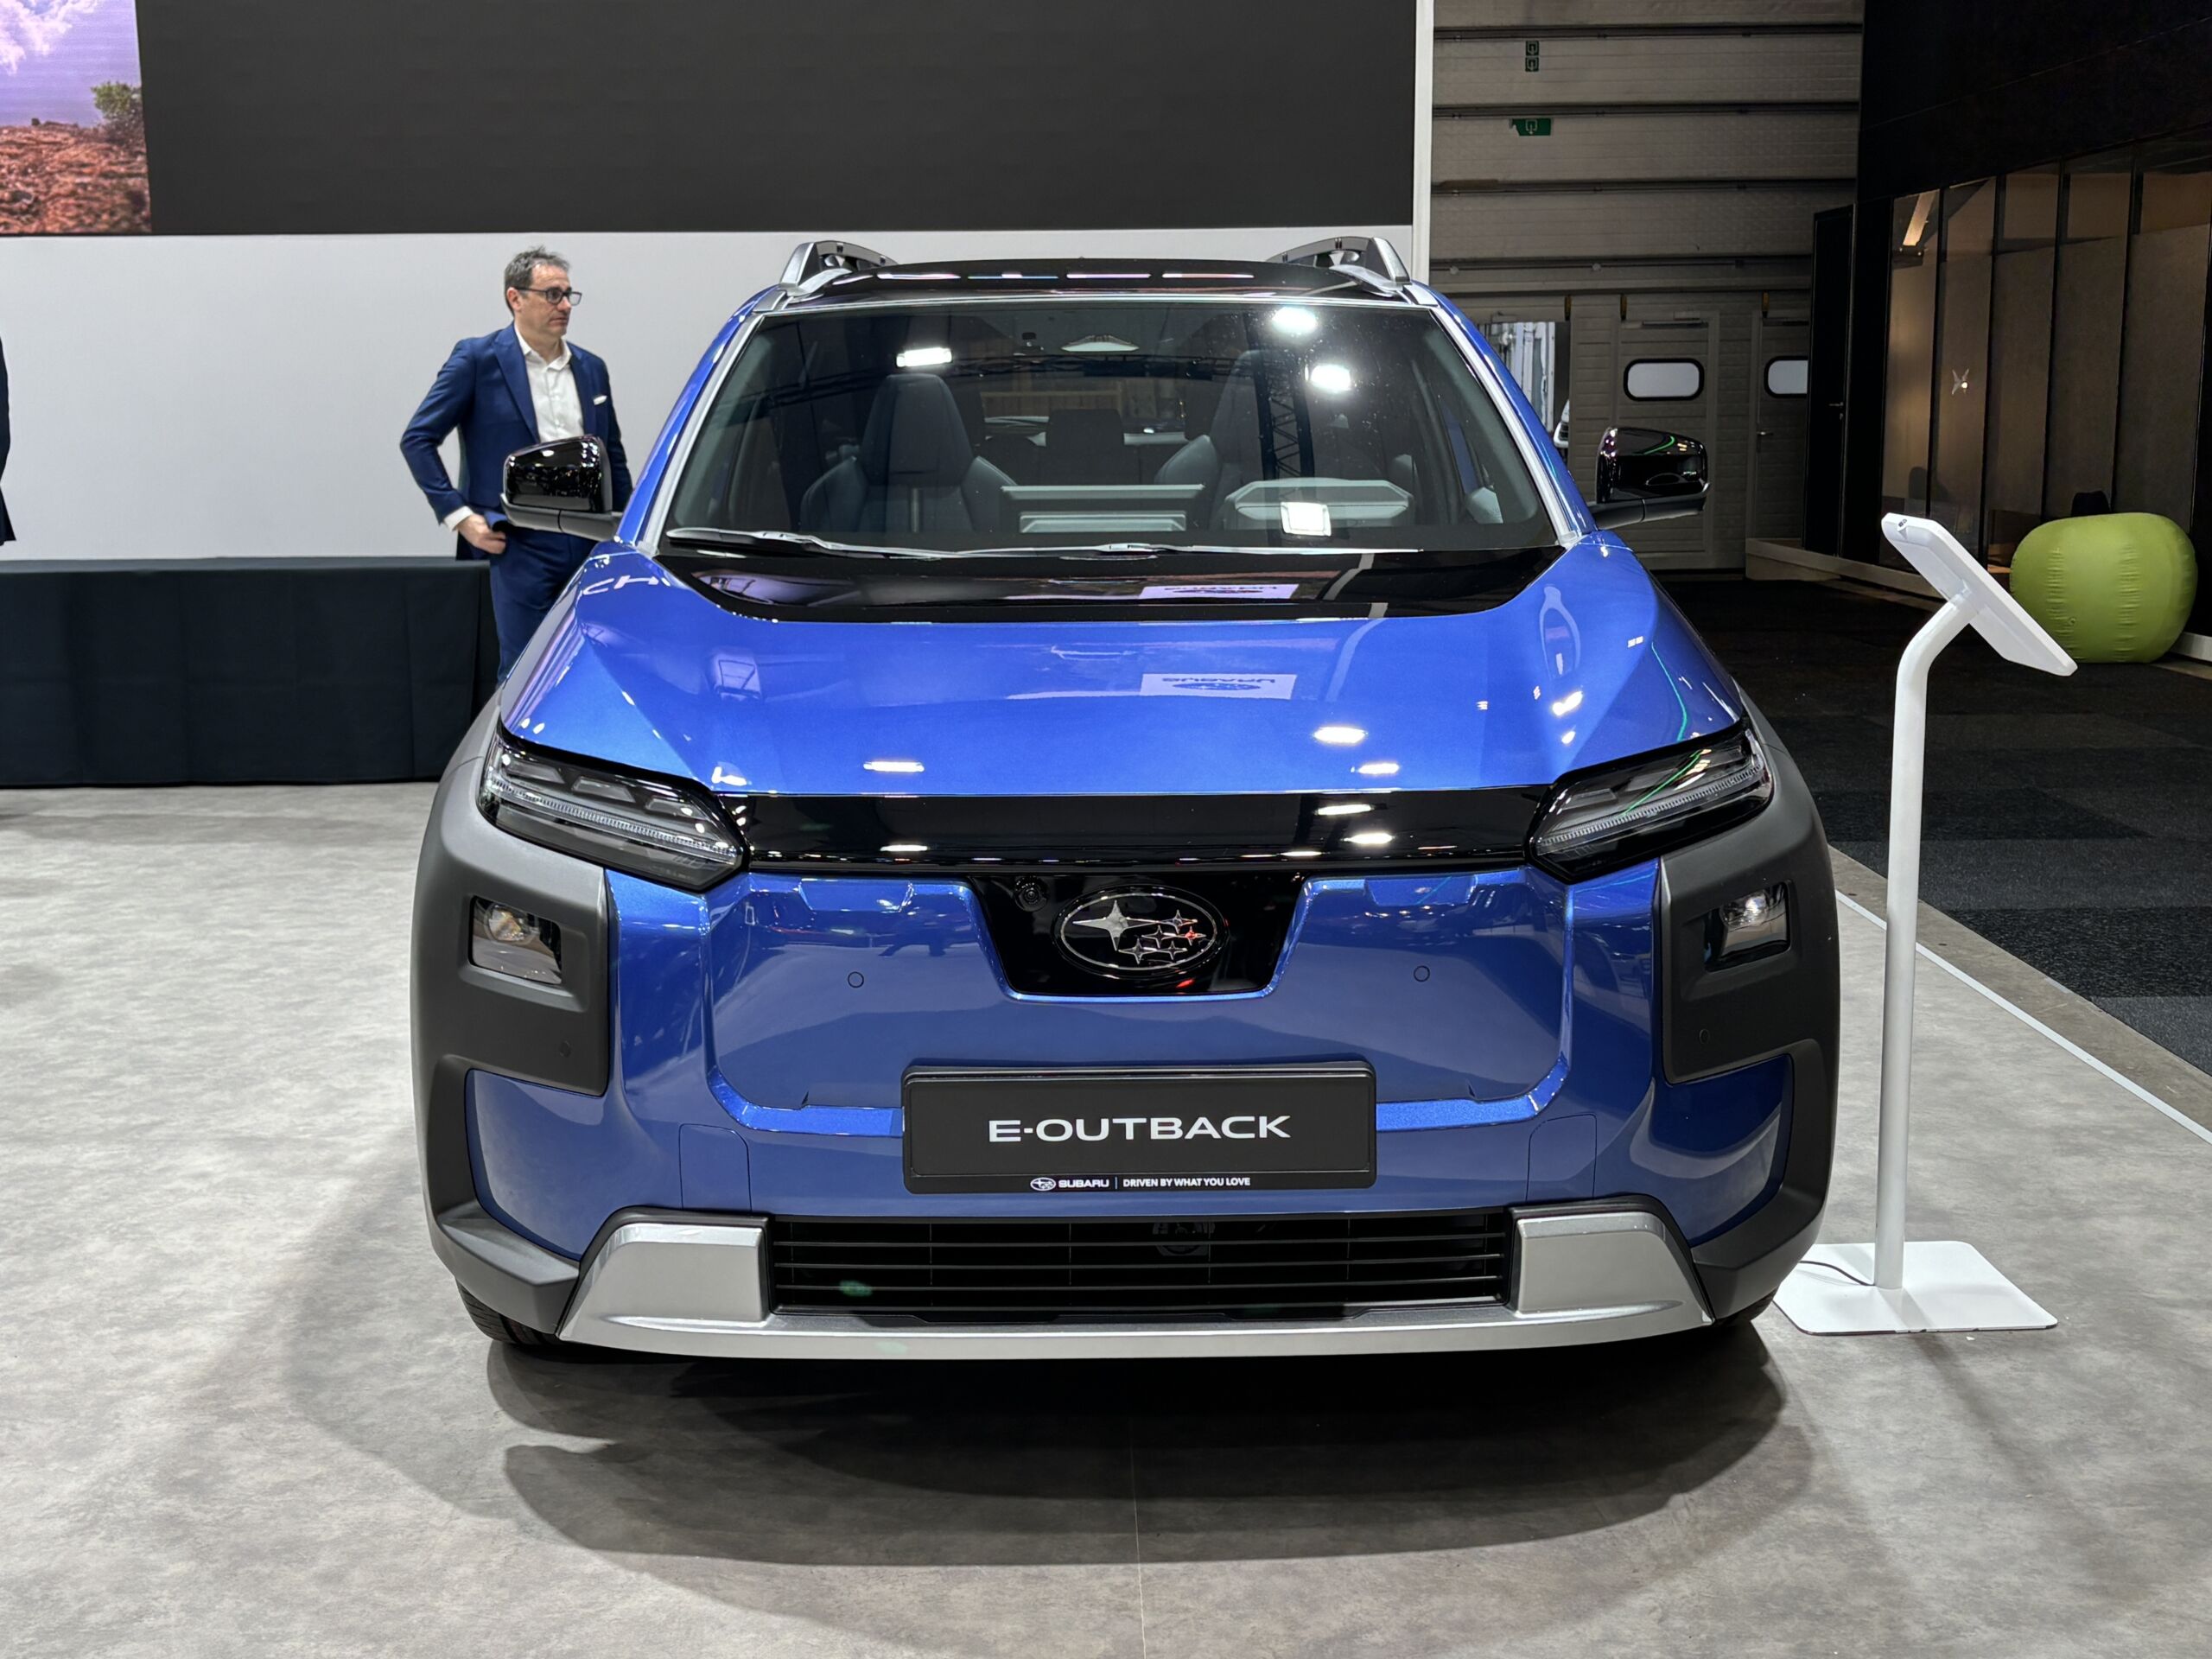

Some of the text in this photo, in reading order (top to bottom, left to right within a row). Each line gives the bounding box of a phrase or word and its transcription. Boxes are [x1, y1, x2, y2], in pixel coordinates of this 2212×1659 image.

[988, 1116, 1291, 1142] E-OUTBACK
[1058, 1177, 1251, 1188] SUBARU DRIVEN BY WHAT YOU LOVE
